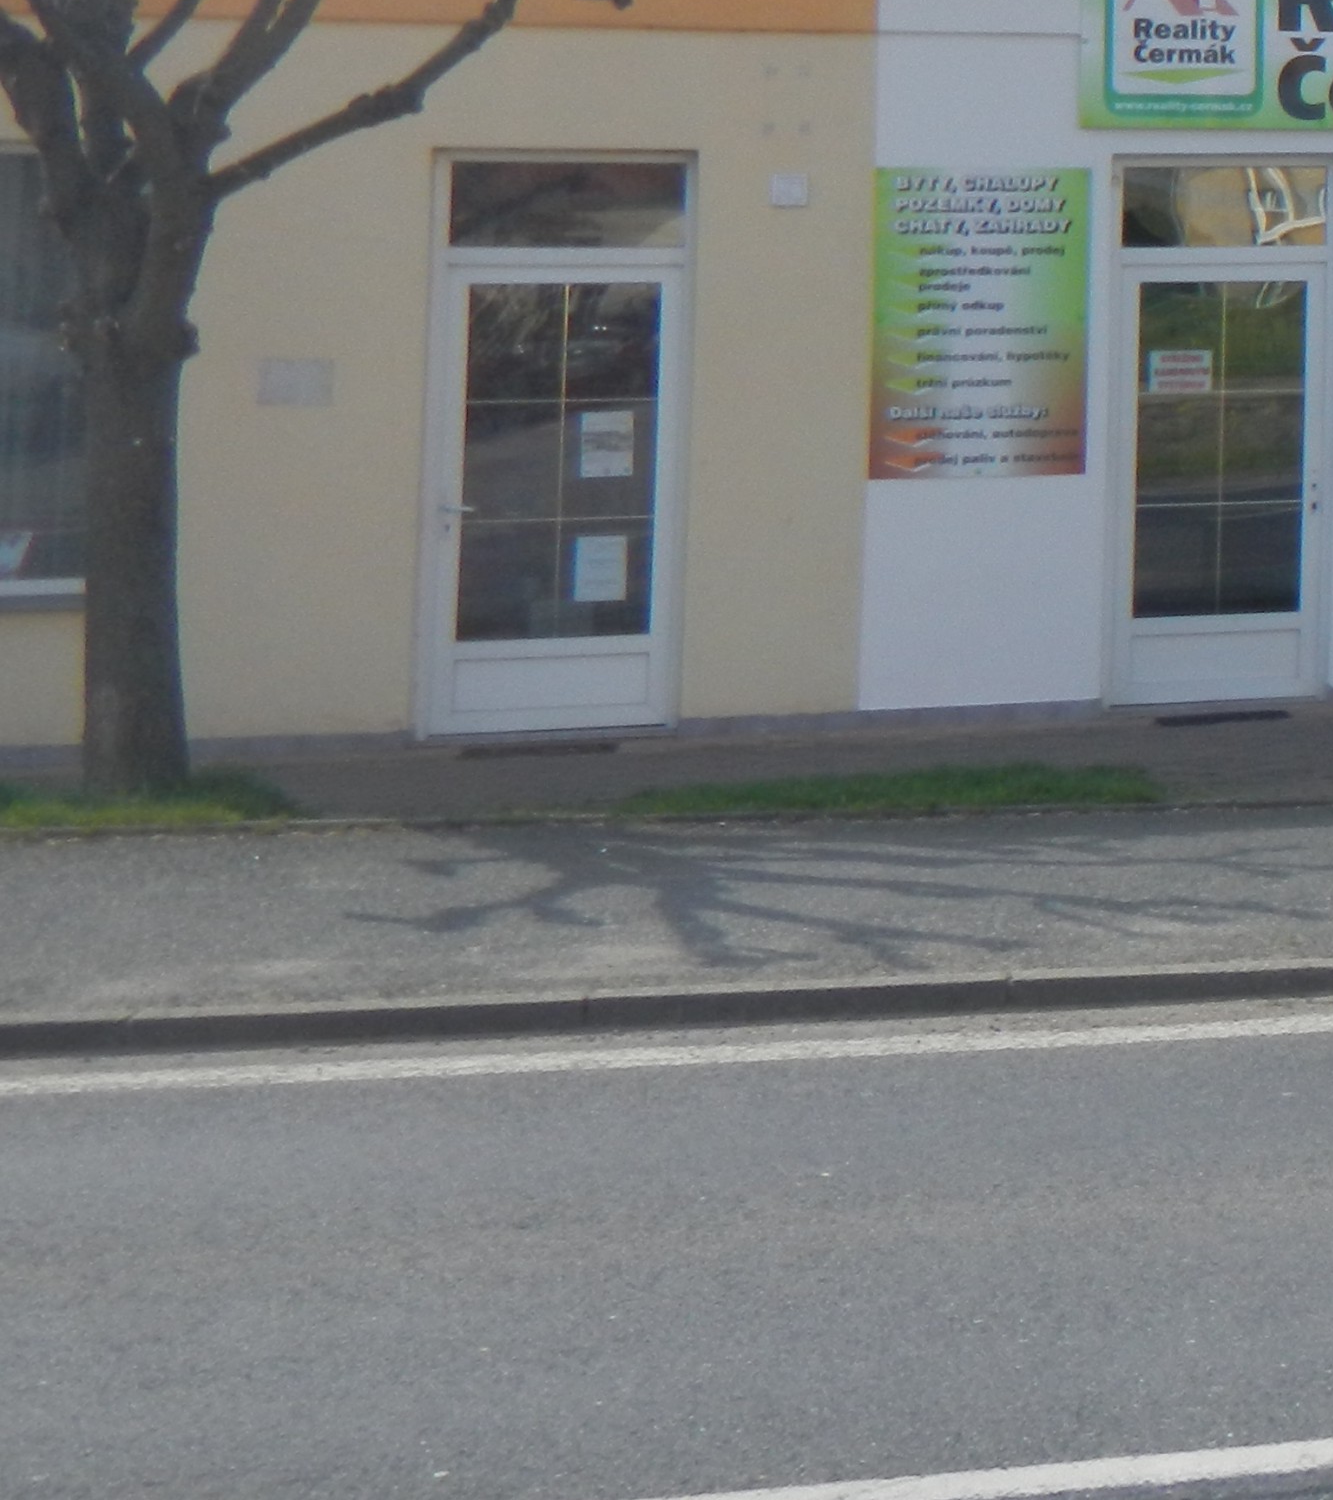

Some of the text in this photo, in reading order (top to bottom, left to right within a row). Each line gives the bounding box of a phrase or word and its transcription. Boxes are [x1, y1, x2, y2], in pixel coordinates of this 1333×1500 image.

[1133, 18, 1237, 42] Reality
[1133, 39, 1236, 64] Čermák
[896, 176, 1060, 193] BYTY, CHALUPY
[895, 198, 1067, 215] POZEMKY, DOMY
[895, 219, 1073, 236] CHATY, ZAHRADY
